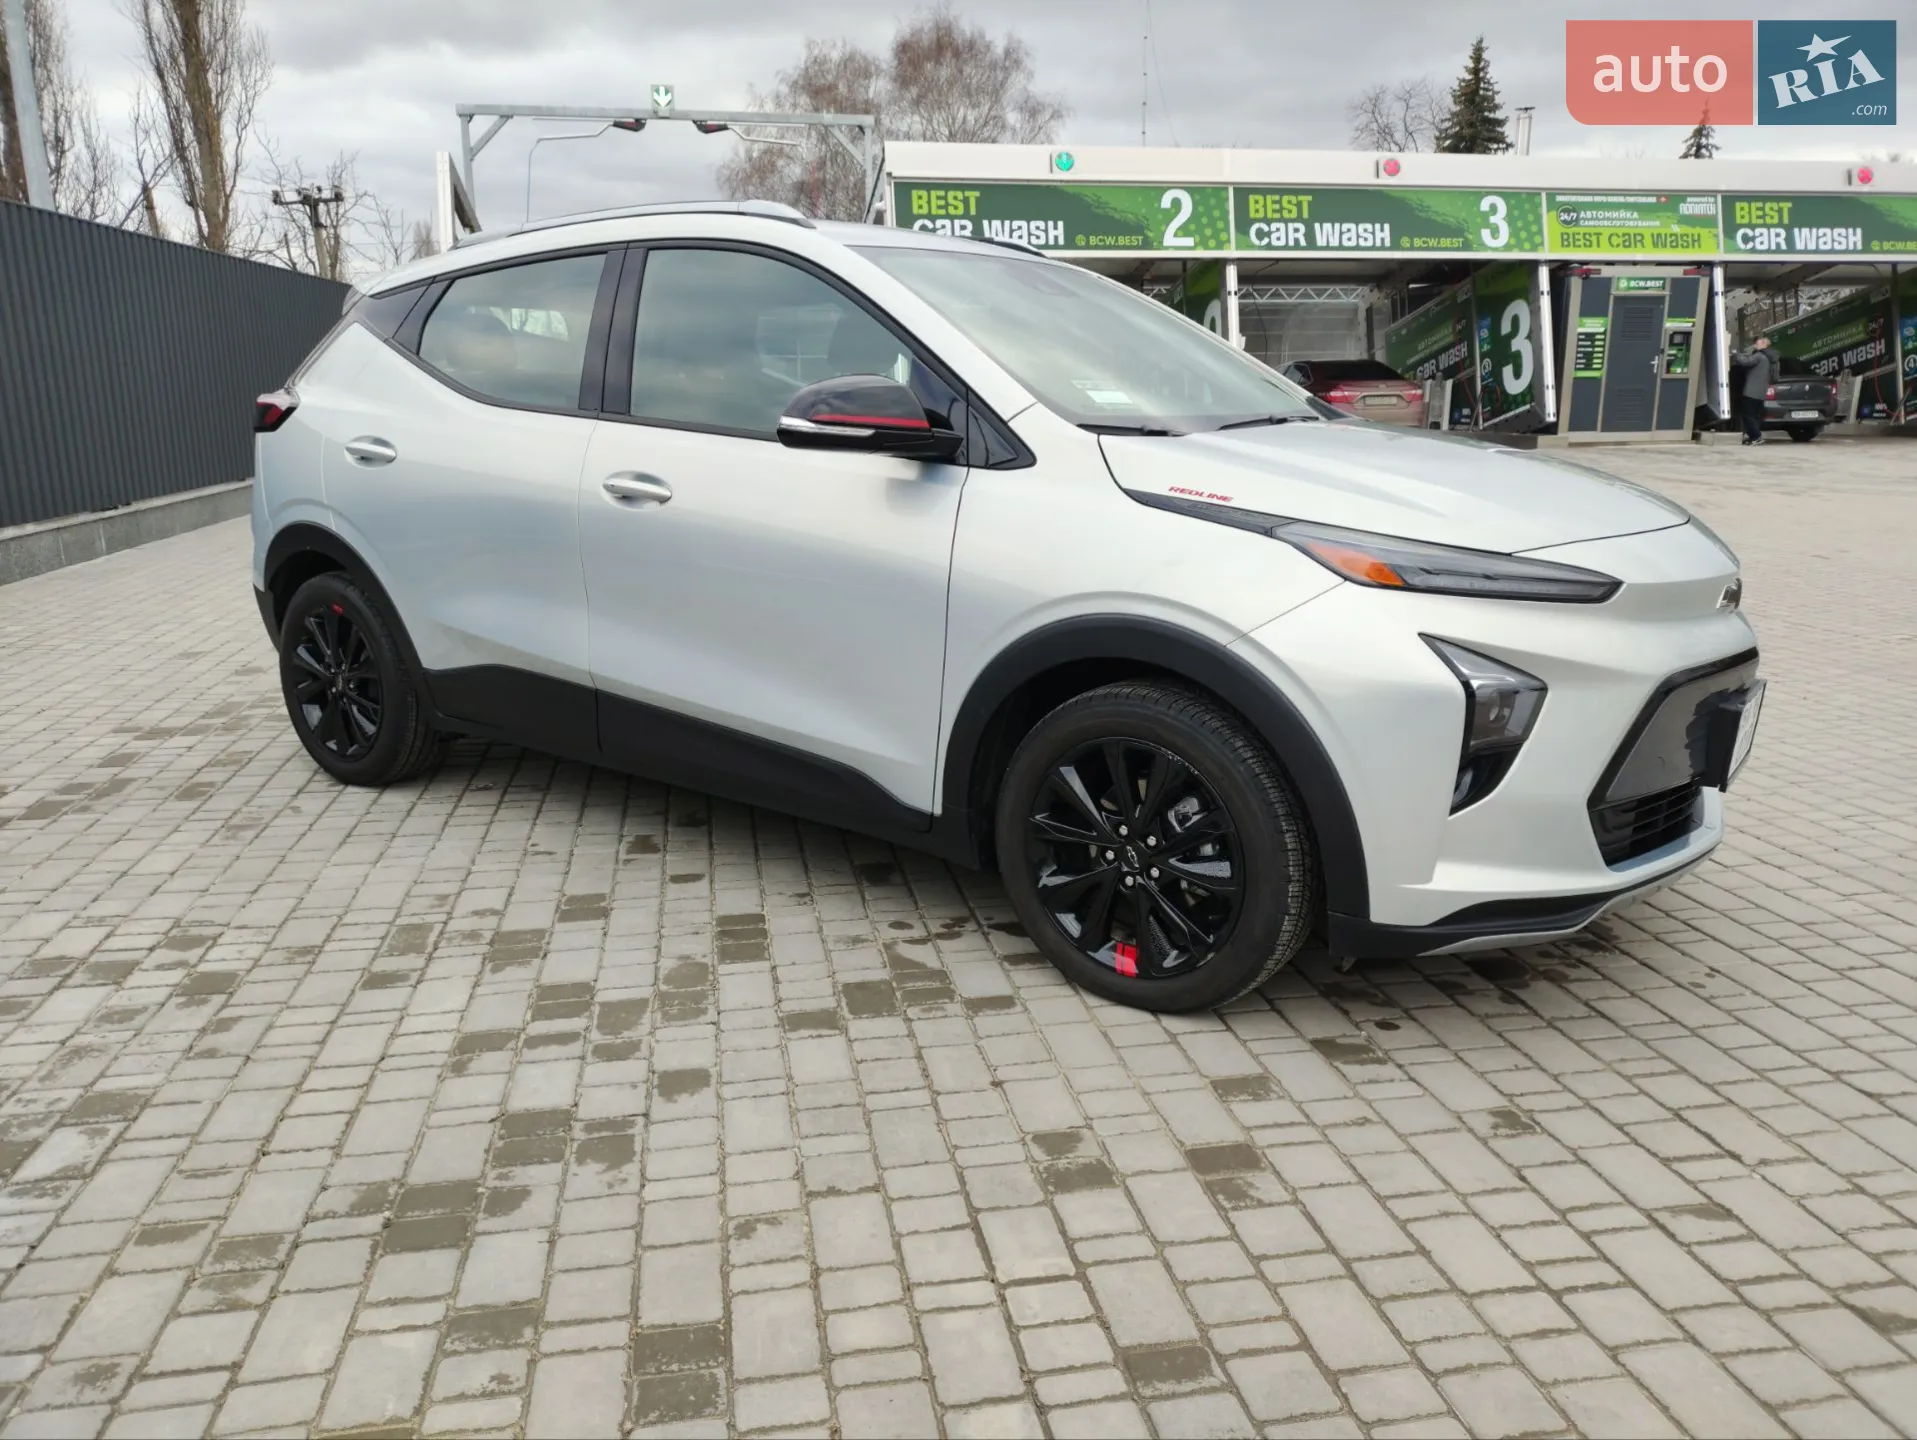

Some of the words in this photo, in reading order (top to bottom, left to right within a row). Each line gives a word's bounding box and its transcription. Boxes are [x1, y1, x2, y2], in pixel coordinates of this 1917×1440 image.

[911, 189, 981, 216] BEST
[1248, 194, 1313, 220] BEST
[1159, 188, 1195, 248] 2
[1479, 194, 1510, 248] 3
[1559, 212, 1578, 222] 24/7
[1579, 209, 1639, 219] АВТОМИЙКА
[1735, 201, 1793, 225] BEST
[1089, 235, 1144, 247] BCW.BEST
[1413, 237, 1464, 248] BCW.BEST
[1560, 232, 1603, 249] BEST
[1501, 298, 1534, 396] 3
[1168, 486, 1233, 502] REDLINE
